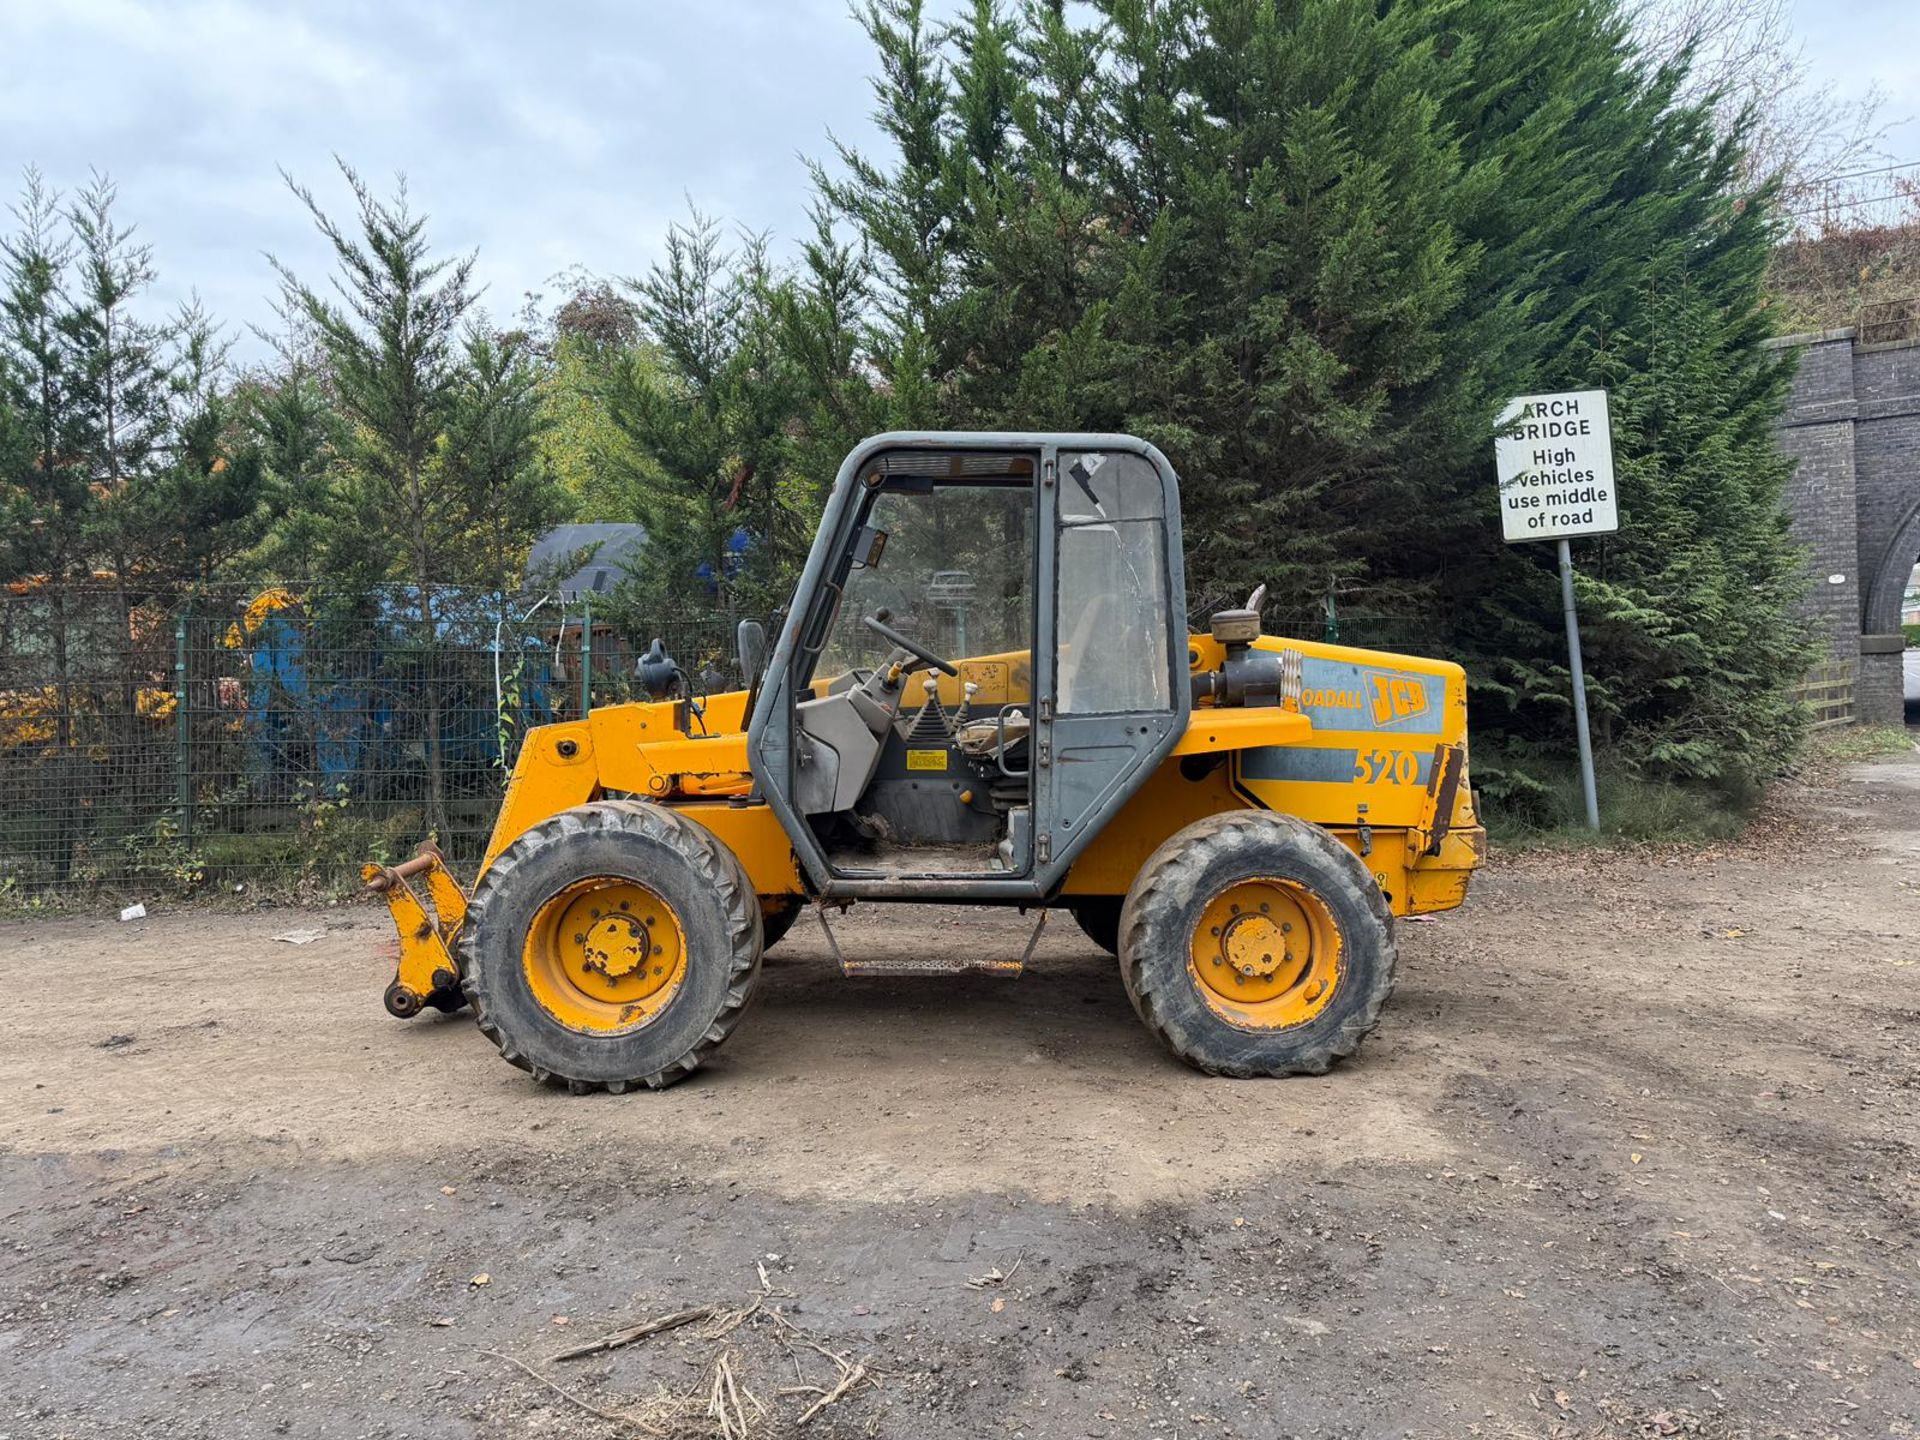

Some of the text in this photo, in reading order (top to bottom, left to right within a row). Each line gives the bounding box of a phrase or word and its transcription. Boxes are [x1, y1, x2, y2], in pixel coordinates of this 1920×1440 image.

[1522, 399, 1579, 419] ARCH
[1513, 419, 1591, 441] BRIDGE
[1533, 448, 1576, 466] High
[1520, 468, 1595, 487] vehicles
[1508, 487, 1608, 509] use middle
[1527, 508, 1593, 529] of road
[1301, 676, 1425, 723] OADALL JCB
[1353, 748, 1418, 785] 520
